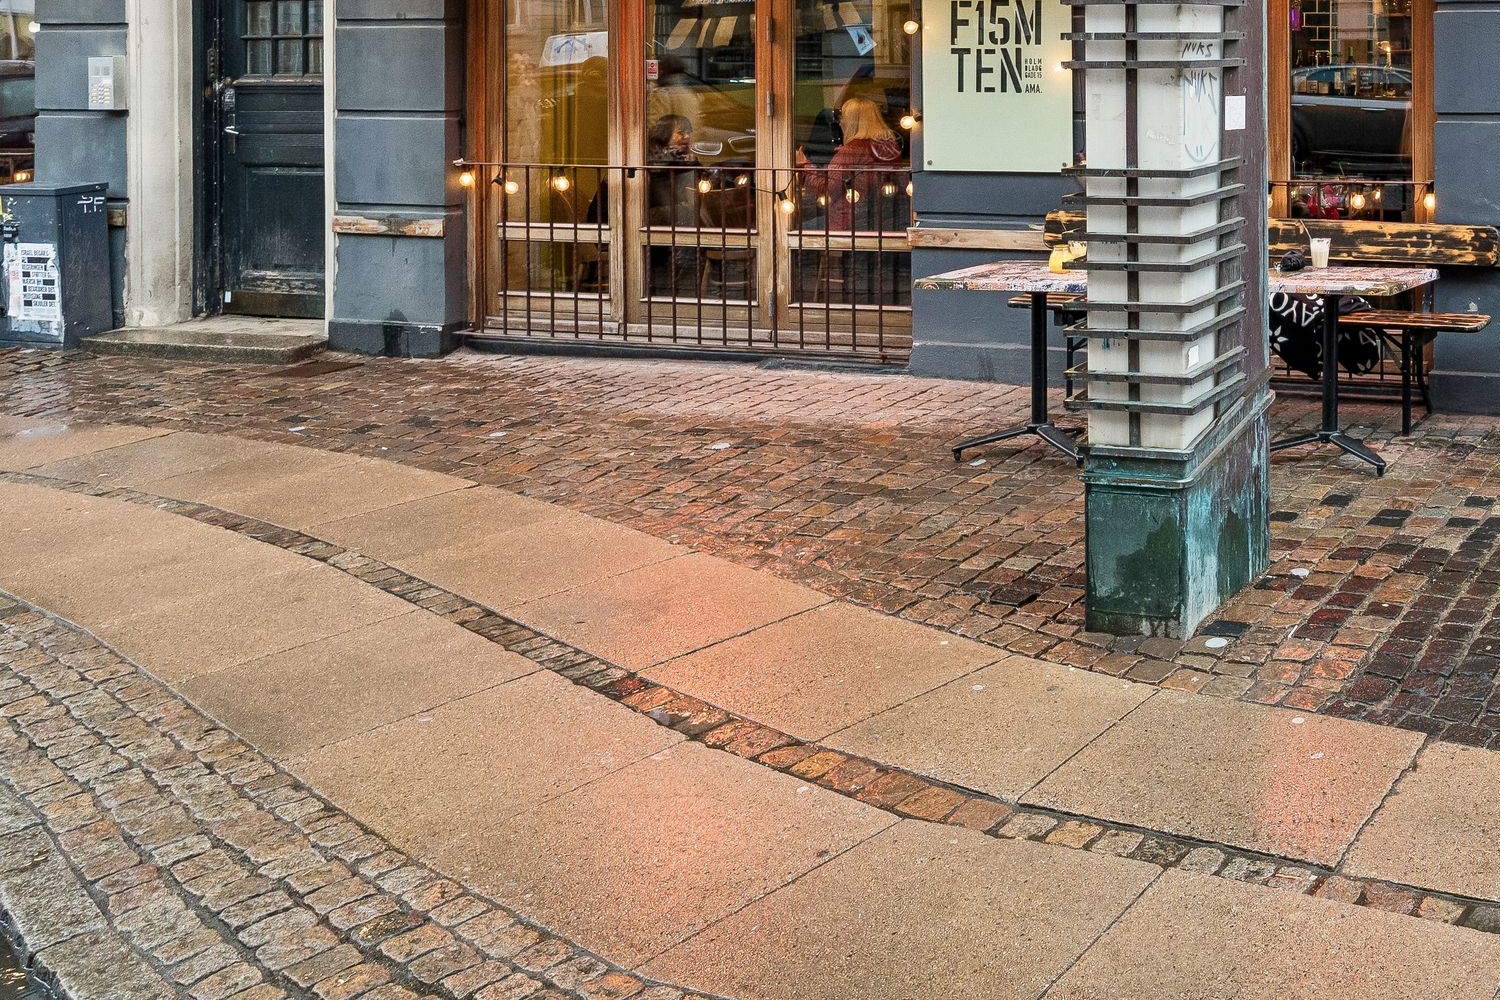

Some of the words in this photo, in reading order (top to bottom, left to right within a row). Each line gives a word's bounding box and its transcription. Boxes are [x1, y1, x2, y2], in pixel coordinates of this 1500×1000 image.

[951, 0, 1042, 46] F15M
[951, 47, 1023, 94] TEN
[1025, 83, 1043, 94] AMA.
